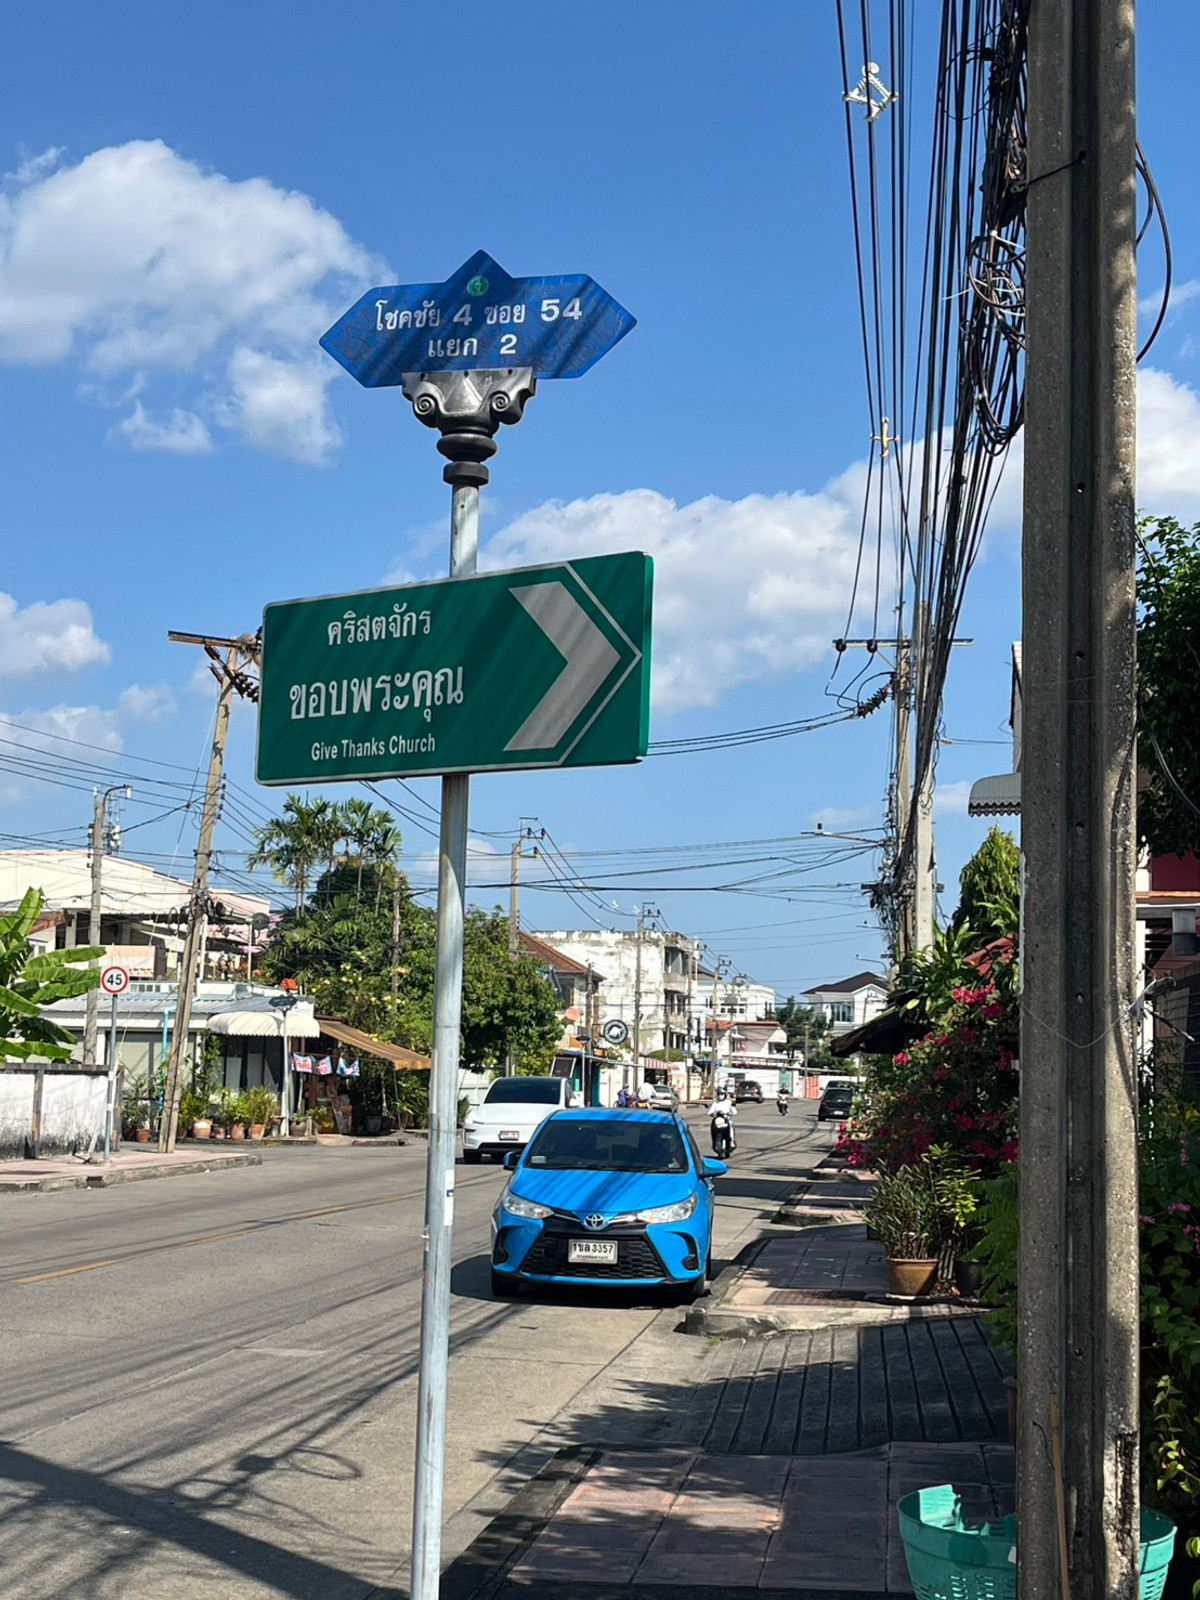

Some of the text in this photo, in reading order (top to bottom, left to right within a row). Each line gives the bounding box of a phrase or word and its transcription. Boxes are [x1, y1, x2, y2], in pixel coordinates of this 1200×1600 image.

[375, 298, 583, 331] โชคชัย 4 ซอย 54
[428, 334, 517, 357] แยก 2
[327, 603, 431, 645] คริสตจักร
[289, 666, 464, 722] ขอบพระคุณ
[311, 733, 436, 761] Give Thanks Church
[107, 973, 123, 986] 45
[591, 1243, 614, 1254] 3357
